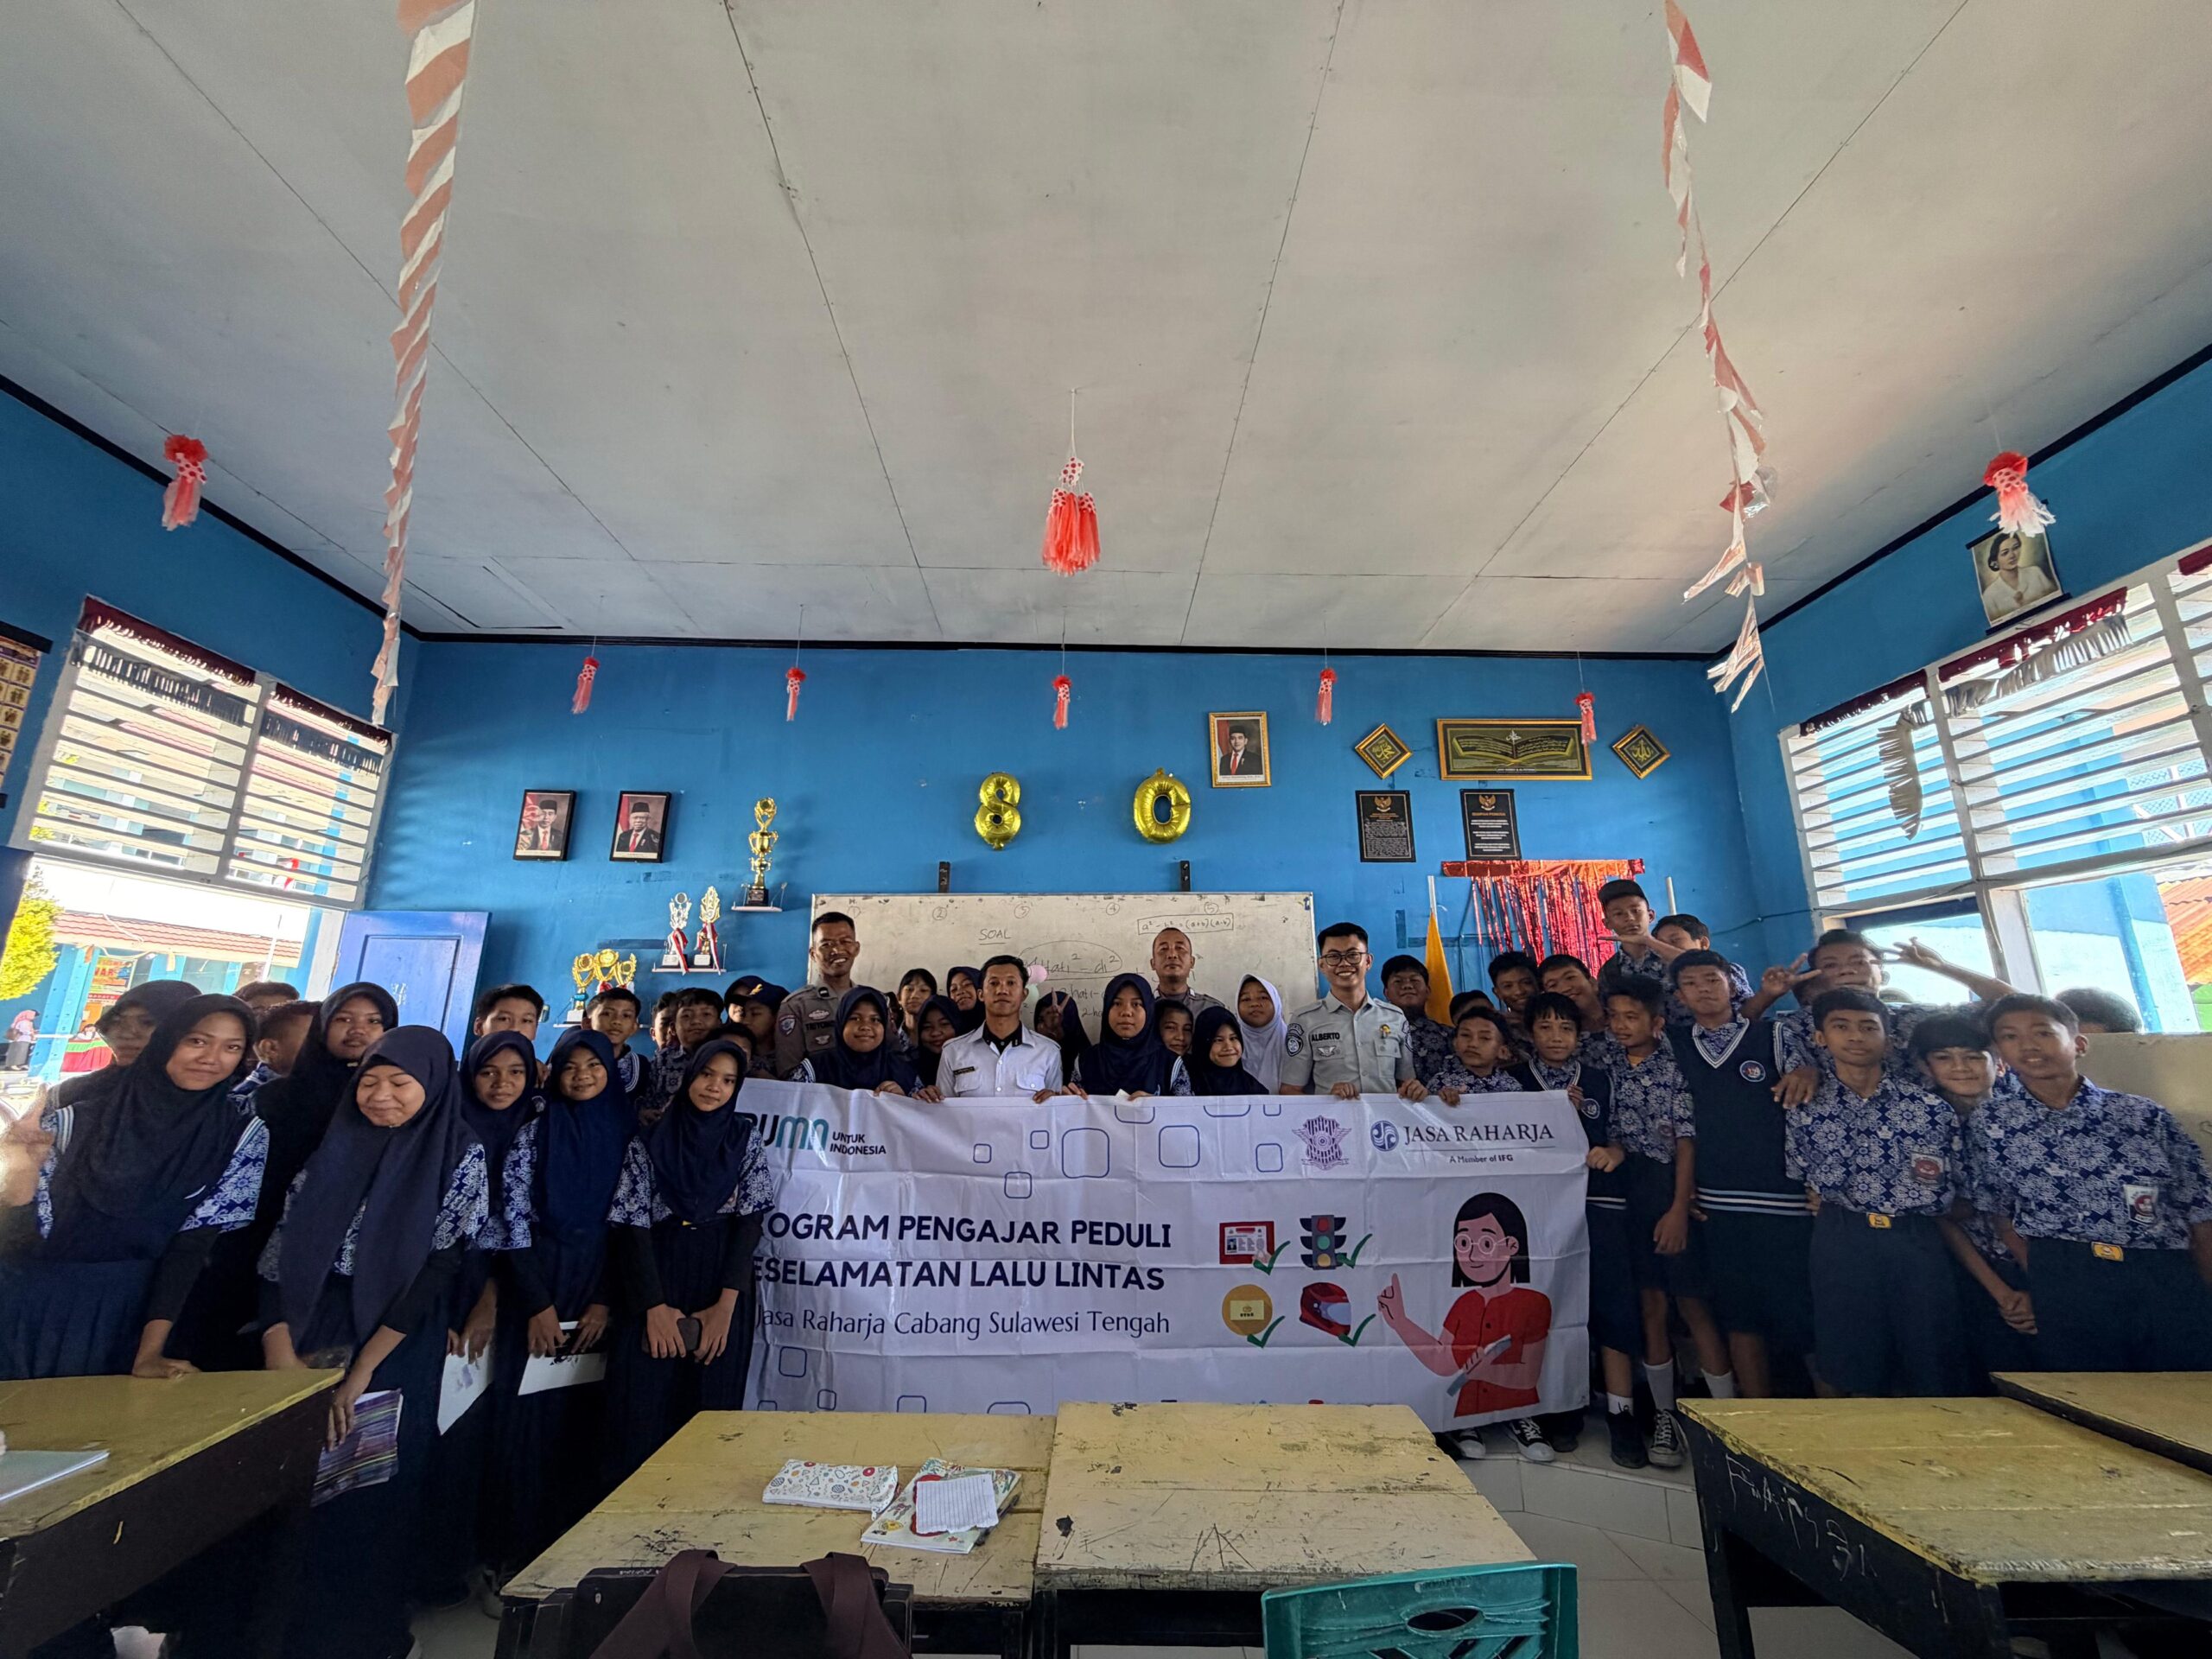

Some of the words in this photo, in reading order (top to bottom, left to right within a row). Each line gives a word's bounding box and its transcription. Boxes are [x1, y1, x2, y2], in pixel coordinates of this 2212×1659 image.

[974, 772, 1021, 849] 8
[979, 929, 1011, 940] SOAL
[1311, 1032, 1340, 1042] ALBERTO
[832, 1131, 866, 1144] UNTUK
[1404, 1125, 1450, 1146] JASA
[1453, 1124, 1555, 1143] RAHARJA
[830, 1143, 887, 1155] INDONESIA
[1458, 1154, 1487, 1163] Member
[1490, 1154, 1497, 1162] of
[1498, 1154, 1514, 1162] IFG
[767, 1212, 889, 1240] OGRAM
[898, 1215, 1061, 1244] PENGAJAR
[1071, 1219, 1172, 1249] PEDULI
[970, 1261, 1046, 1287] LALU
[1055, 1261, 1166, 1291] LINTAS
[755, 1304, 794, 1328] Jasa
[803, 1309, 886, 1342] Raharja
[893, 1311, 981, 1341] Cabang
[988, 1311, 1079, 1334] Sulawesi
[1086, 1311, 1170, 1339] Tengah
